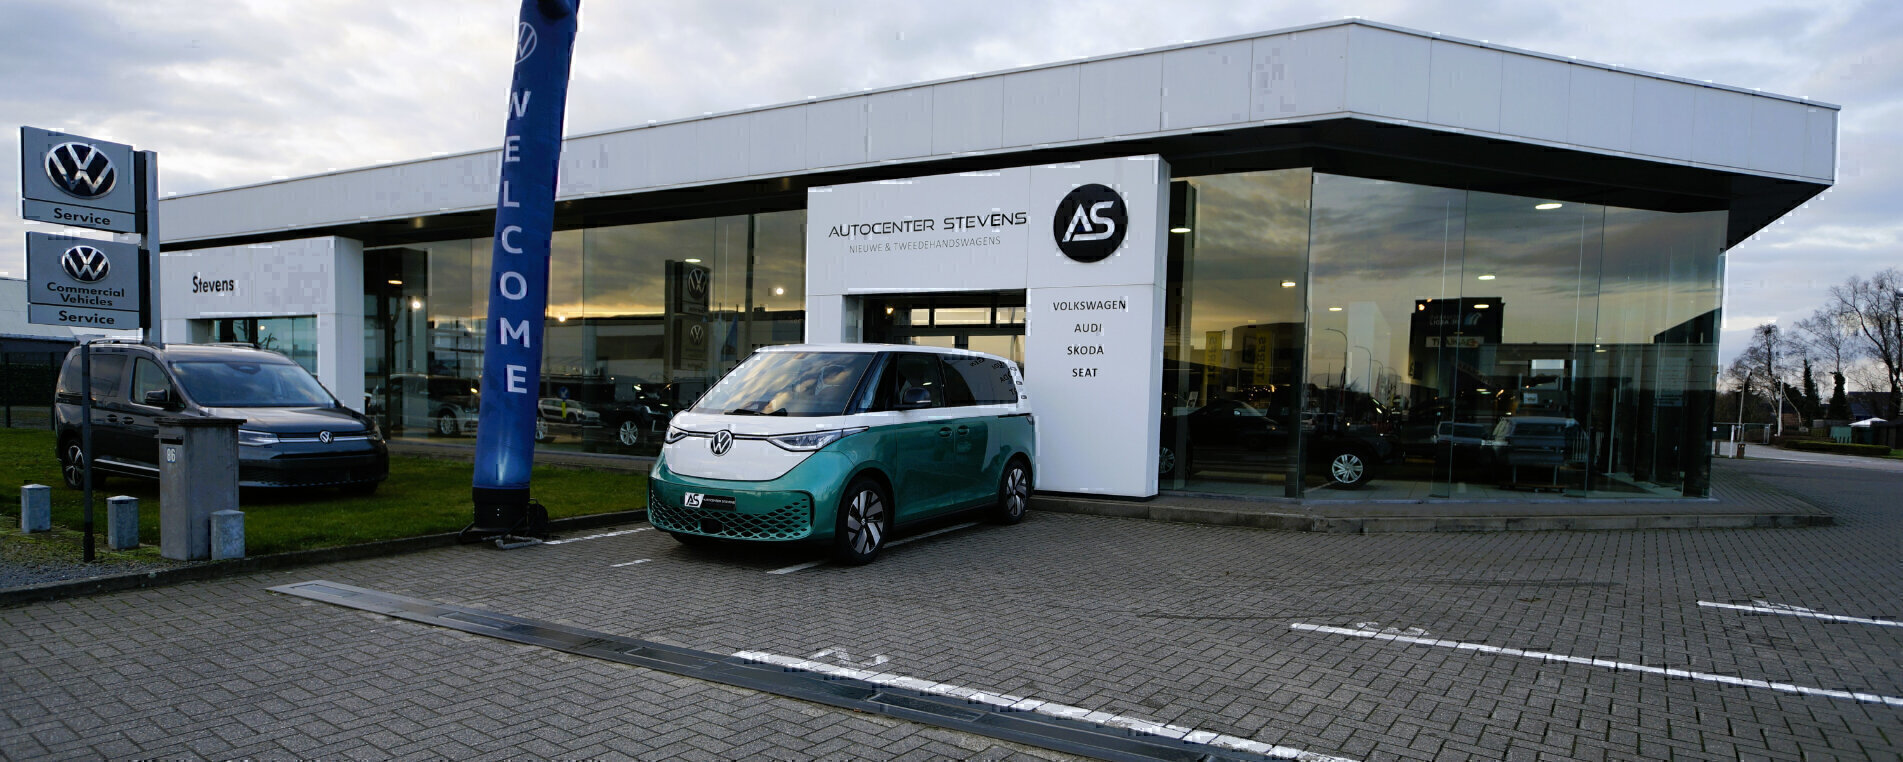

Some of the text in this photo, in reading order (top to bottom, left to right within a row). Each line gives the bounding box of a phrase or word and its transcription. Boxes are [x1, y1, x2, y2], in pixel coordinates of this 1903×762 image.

[53, 208, 111, 225] Service
[828, 211, 1027, 238] AUTOCENTER STEVENS
[1062, 200, 1122, 243] AS
[500, 90, 532, 394] WELCOME
[849, 236, 1001, 254] NIEUWE & TWEEDEHANDSWAGENS
[47, 281, 125, 297] Commercial
[192, 275, 235, 294] Stevens
[60, 293, 113, 306] Vehicles
[1053, 300, 1126, 311] VOLKSWAGEN
[58, 310, 115, 325] Service
[1074, 323, 1102, 333] AUDI
[1067, 345, 1104, 355] SKODA
[1072, 368, 1098, 377] SEAT
